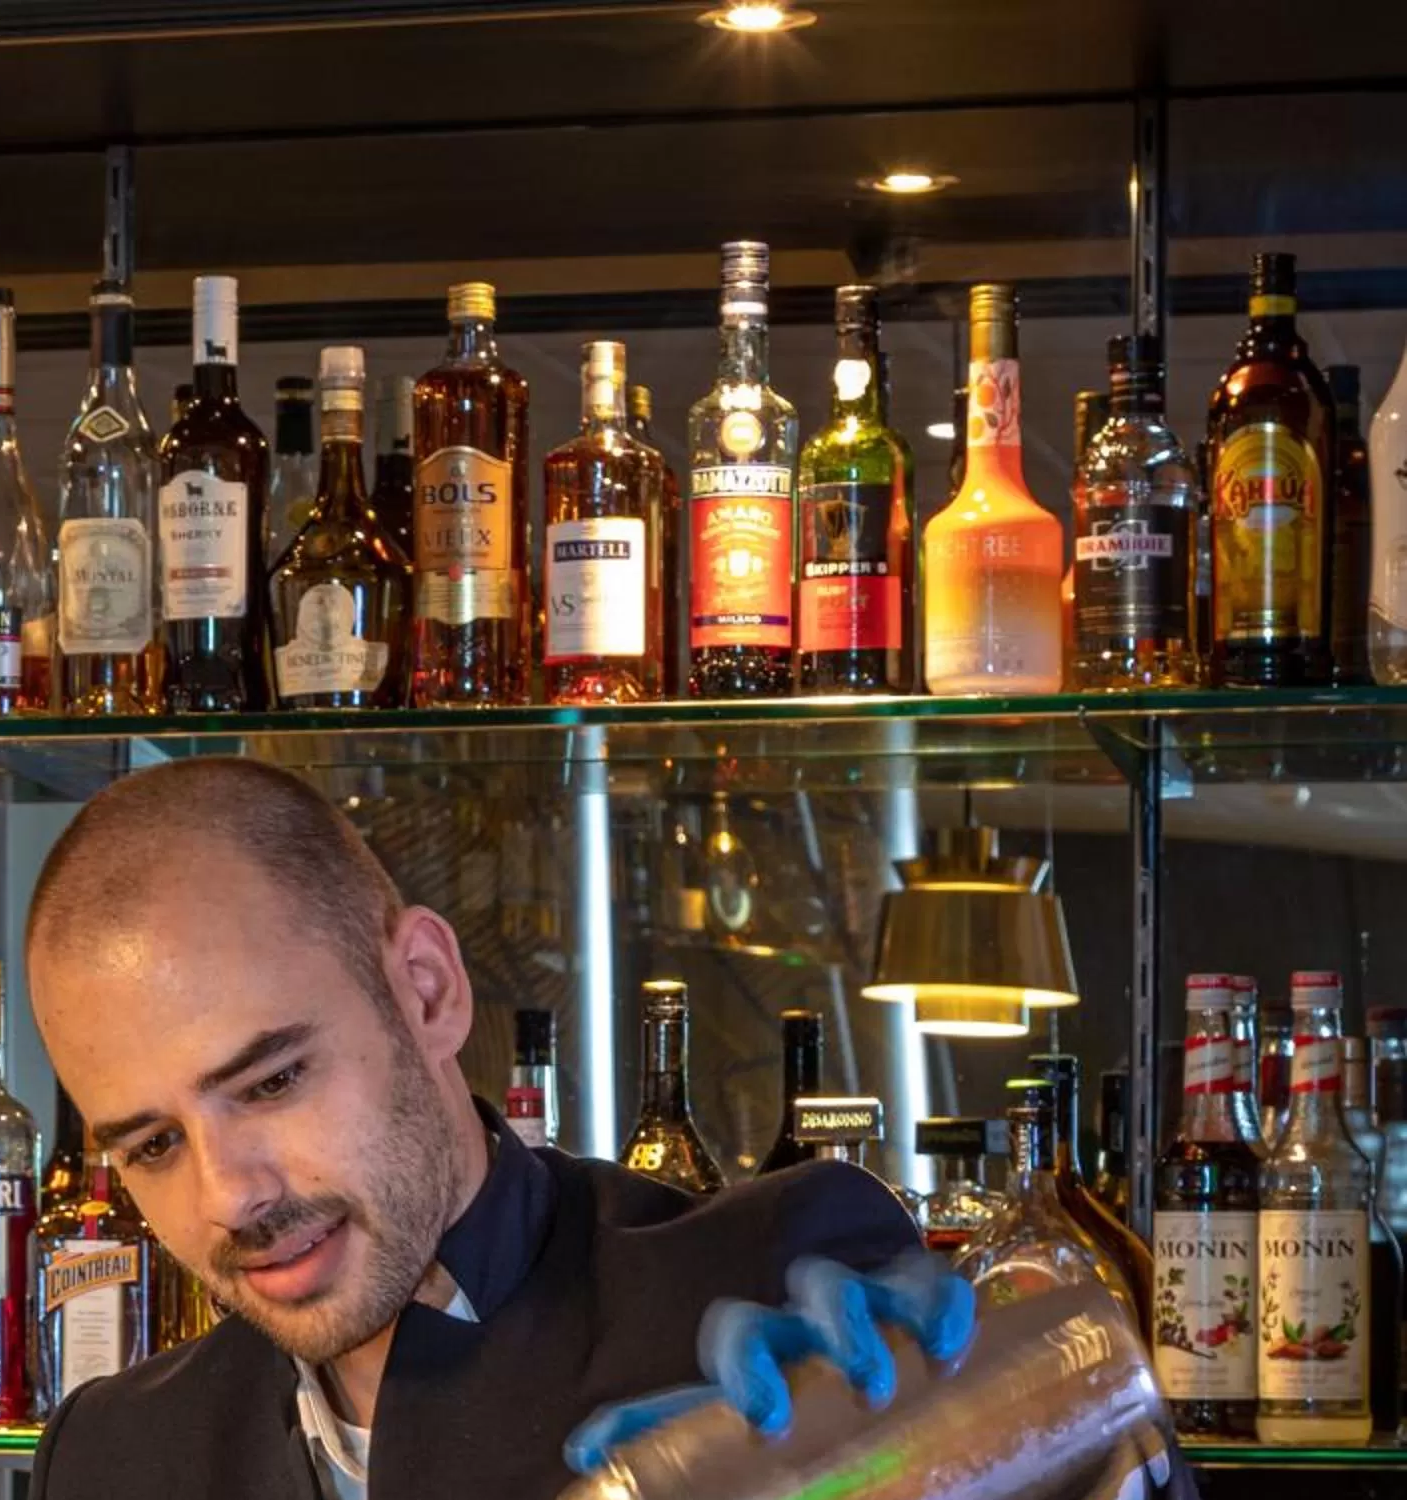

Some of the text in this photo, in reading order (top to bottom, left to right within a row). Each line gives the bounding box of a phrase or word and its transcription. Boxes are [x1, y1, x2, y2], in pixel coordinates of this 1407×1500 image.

[422, 483, 497, 504] BOLS
[555, 542, 627, 559] MARTELL
[1157, 1239, 1249, 1259] MONIN
[1265, 1239, 1356, 1259] MONIN
[51, 1253, 132, 1298] COINTREAU
